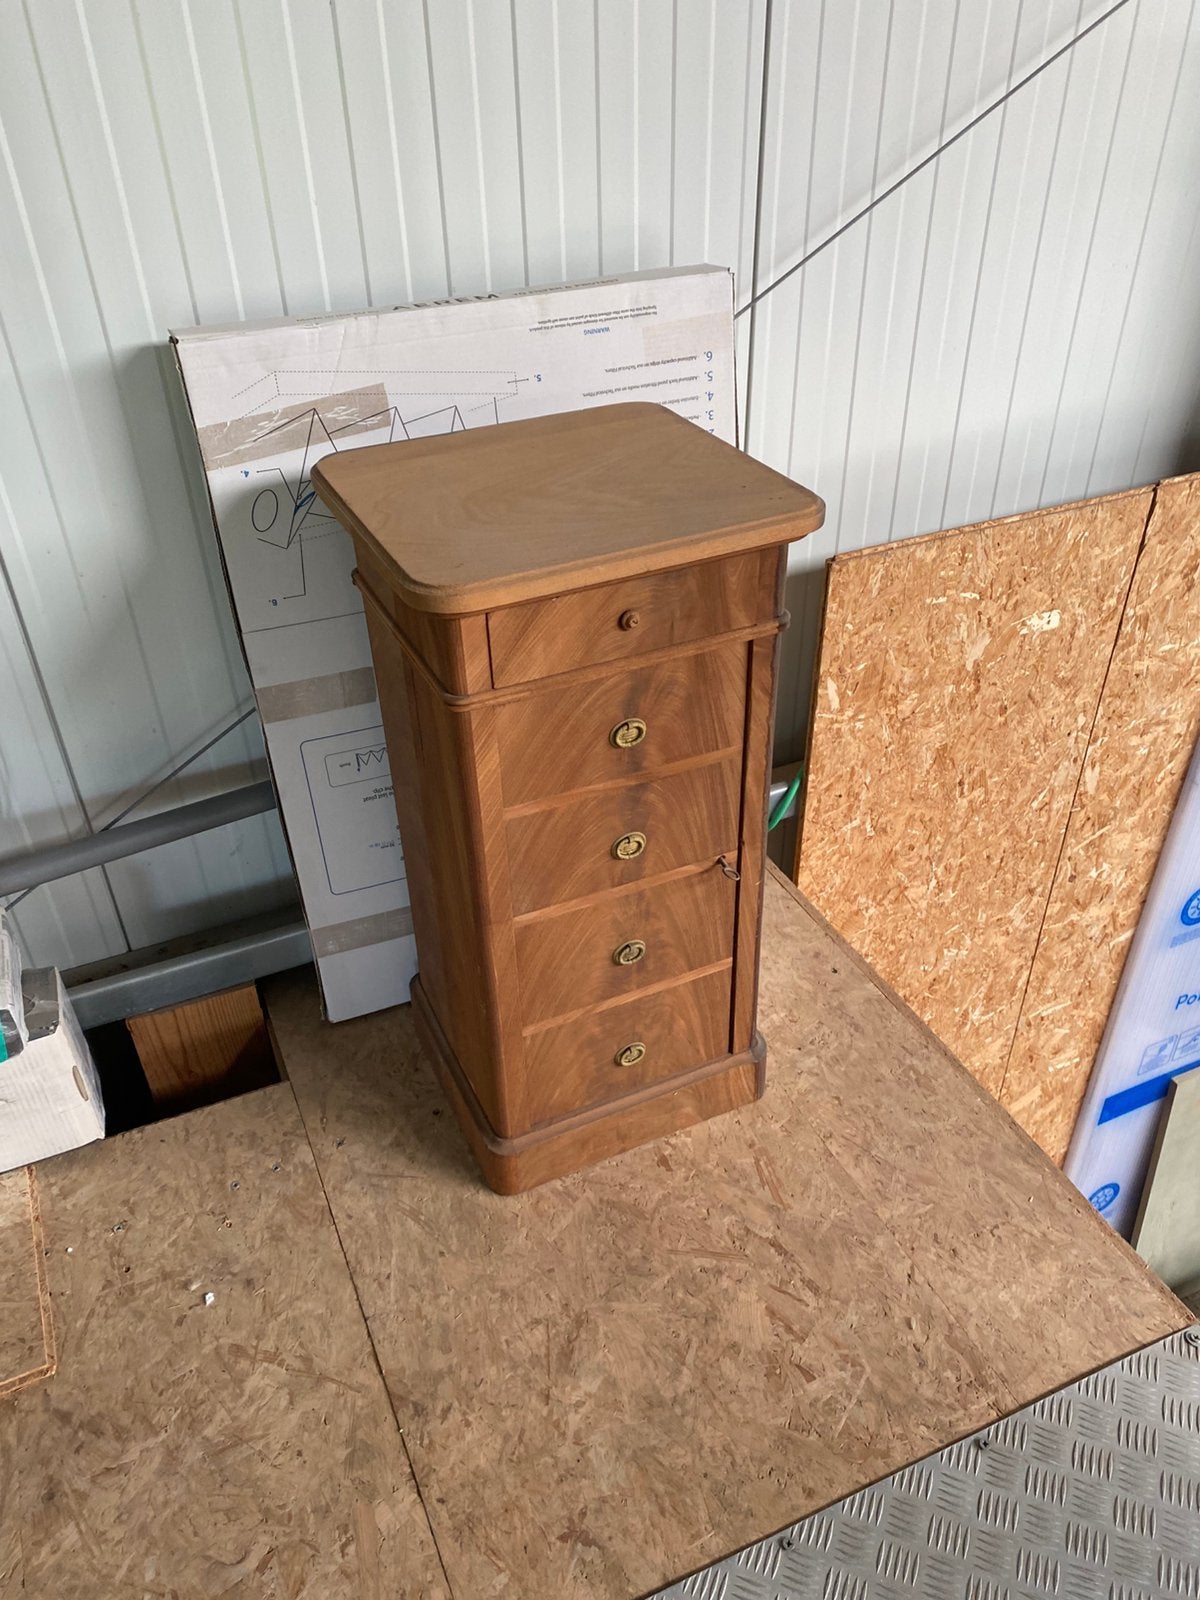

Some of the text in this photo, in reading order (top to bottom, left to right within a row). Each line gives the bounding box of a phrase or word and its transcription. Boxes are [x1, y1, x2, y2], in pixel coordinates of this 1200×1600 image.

[583, 327, 610, 336] WARNING
[704, 351, 712, 362] 6.
[704, 371, 713, 382] 5.
[705, 391, 714, 401] 4.
[706, 410, 714, 420] 3.
